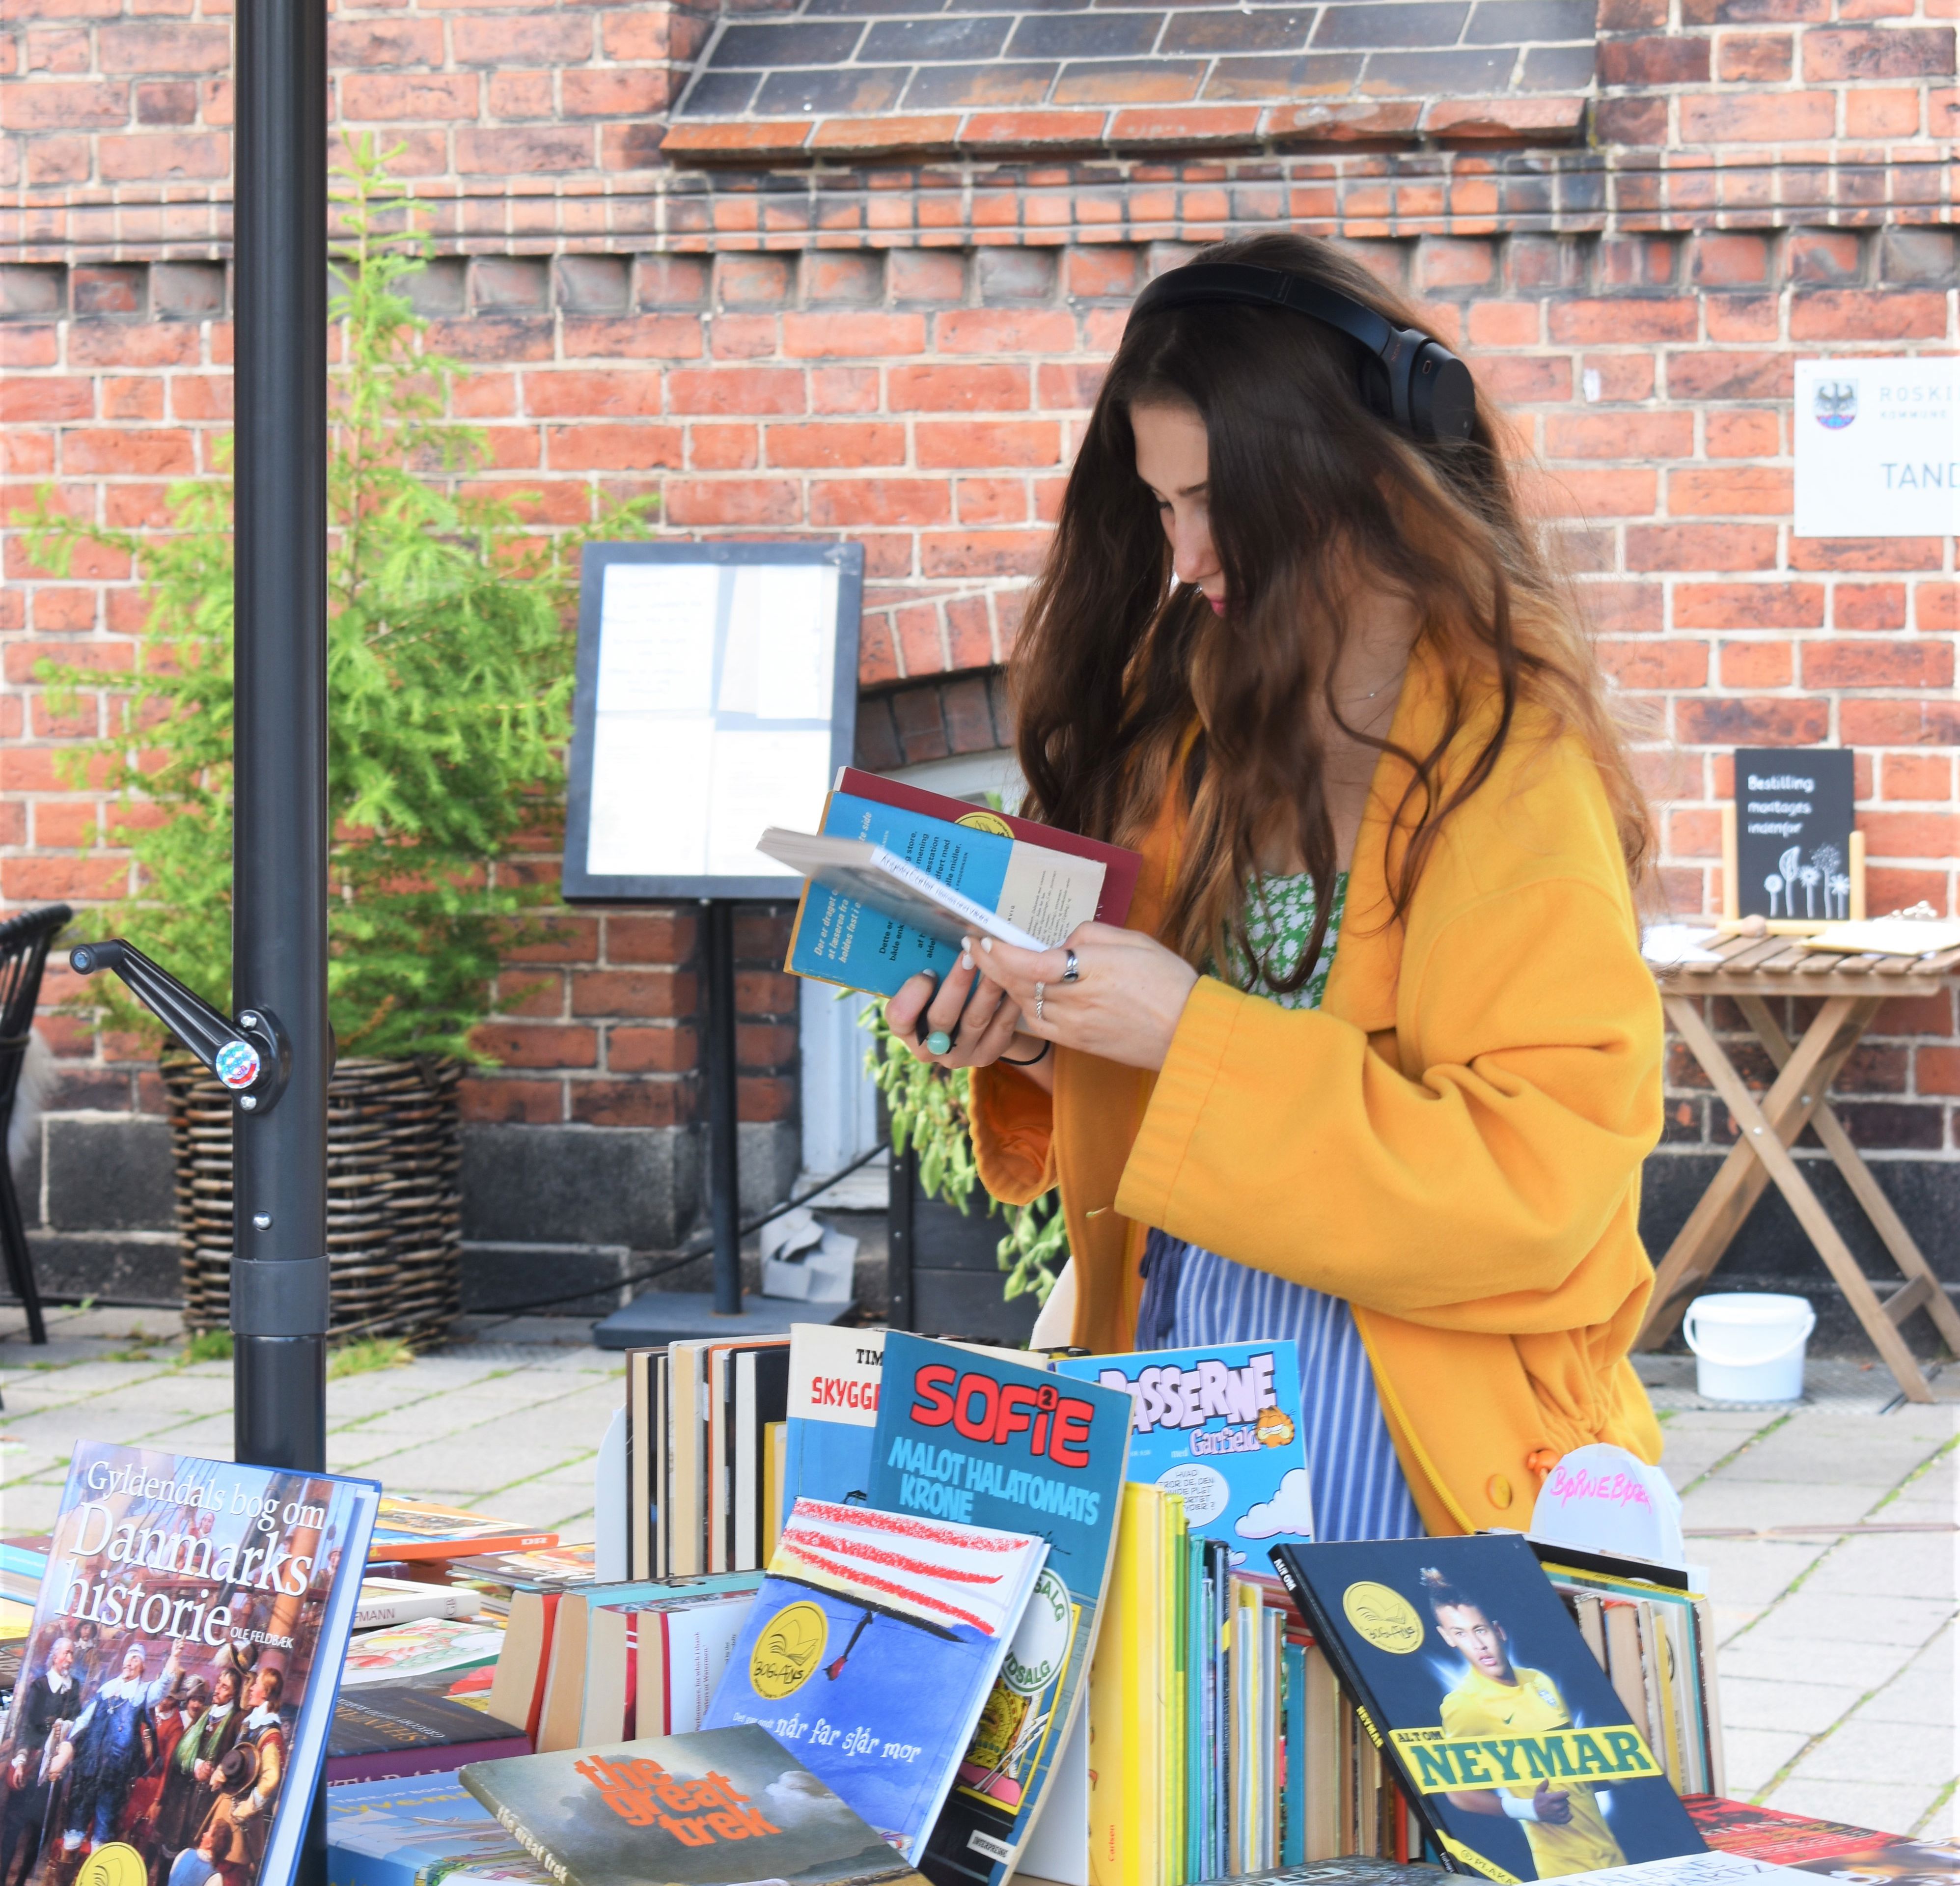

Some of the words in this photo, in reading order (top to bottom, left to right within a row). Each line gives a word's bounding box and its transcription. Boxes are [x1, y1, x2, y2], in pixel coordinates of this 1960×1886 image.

[1879, 386, 1960, 402] ROSKI
[1747, 774, 1815, 793] Bestilling
[1748, 800, 1812, 816] modtages
[1748, 822, 1804, 838] indenfor
[948, 842, 963, 872] midler.
[826, 948, 836, 960] at
[839, 898, 849, 912] fra
[860, 811, 873, 832] side
[888, 940, 901, 962] både
[915, 833, 930, 865] mening
[915, 939, 924, 948] af
[940, 839, 951, 858] med
[821, 895, 838, 927] draget
[813, 938, 827, 957] Der
[820, 927, 829, 938] er
[838, 934, 854, 964] holdes
[847, 914, 859, 933] fast
[878, 930, 891, 954] Dette
[886, 920, 894, 930] er
[1189, 1425, 1261, 1457] Garfield
[87, 1461, 226, 1512] Gyldendals
[229, 1483, 280, 1532] bog
[282, 1502, 326, 1530] om
[887, 1436, 966, 1486] MALOT
[966, 1457, 1101, 1526] HALATOMATS
[900, 1474, 974, 1523] KRONE
[69, 1502, 314, 1596] Danmarks
[521, 1537, 548, 1546] DR
[1283, 1573, 1298, 1591] OM
[54, 1558, 232, 1646] historie
[230, 1626, 250, 1641] OLE
[250, 1631, 294, 1649] FELDBÆK
[396, 1719, 445, 1738] GREGORY
[773, 1712, 809, 1739] når
[808, 1718, 841, 1746] far
[842, 1726, 881, 1757] slår
[880, 1742, 922, 1763] mor
[1356, 1705, 1385, 1749] NEYMAR
[1398, 1732, 1422, 1743] ALT
[1423, 1730, 1444, 1741] OM
[574, 1755, 672, 1792] the
[1410, 1731, 1652, 1787] NEYMAR
[600, 1771, 751, 1827] great
[496, 1805, 515, 1833] the
[514, 1827, 545, 1862] great
[544, 1852, 569, 1885] trek
[658, 1806, 783, 1847] trek
[1107, 1825, 1116, 1862] Carlsen
